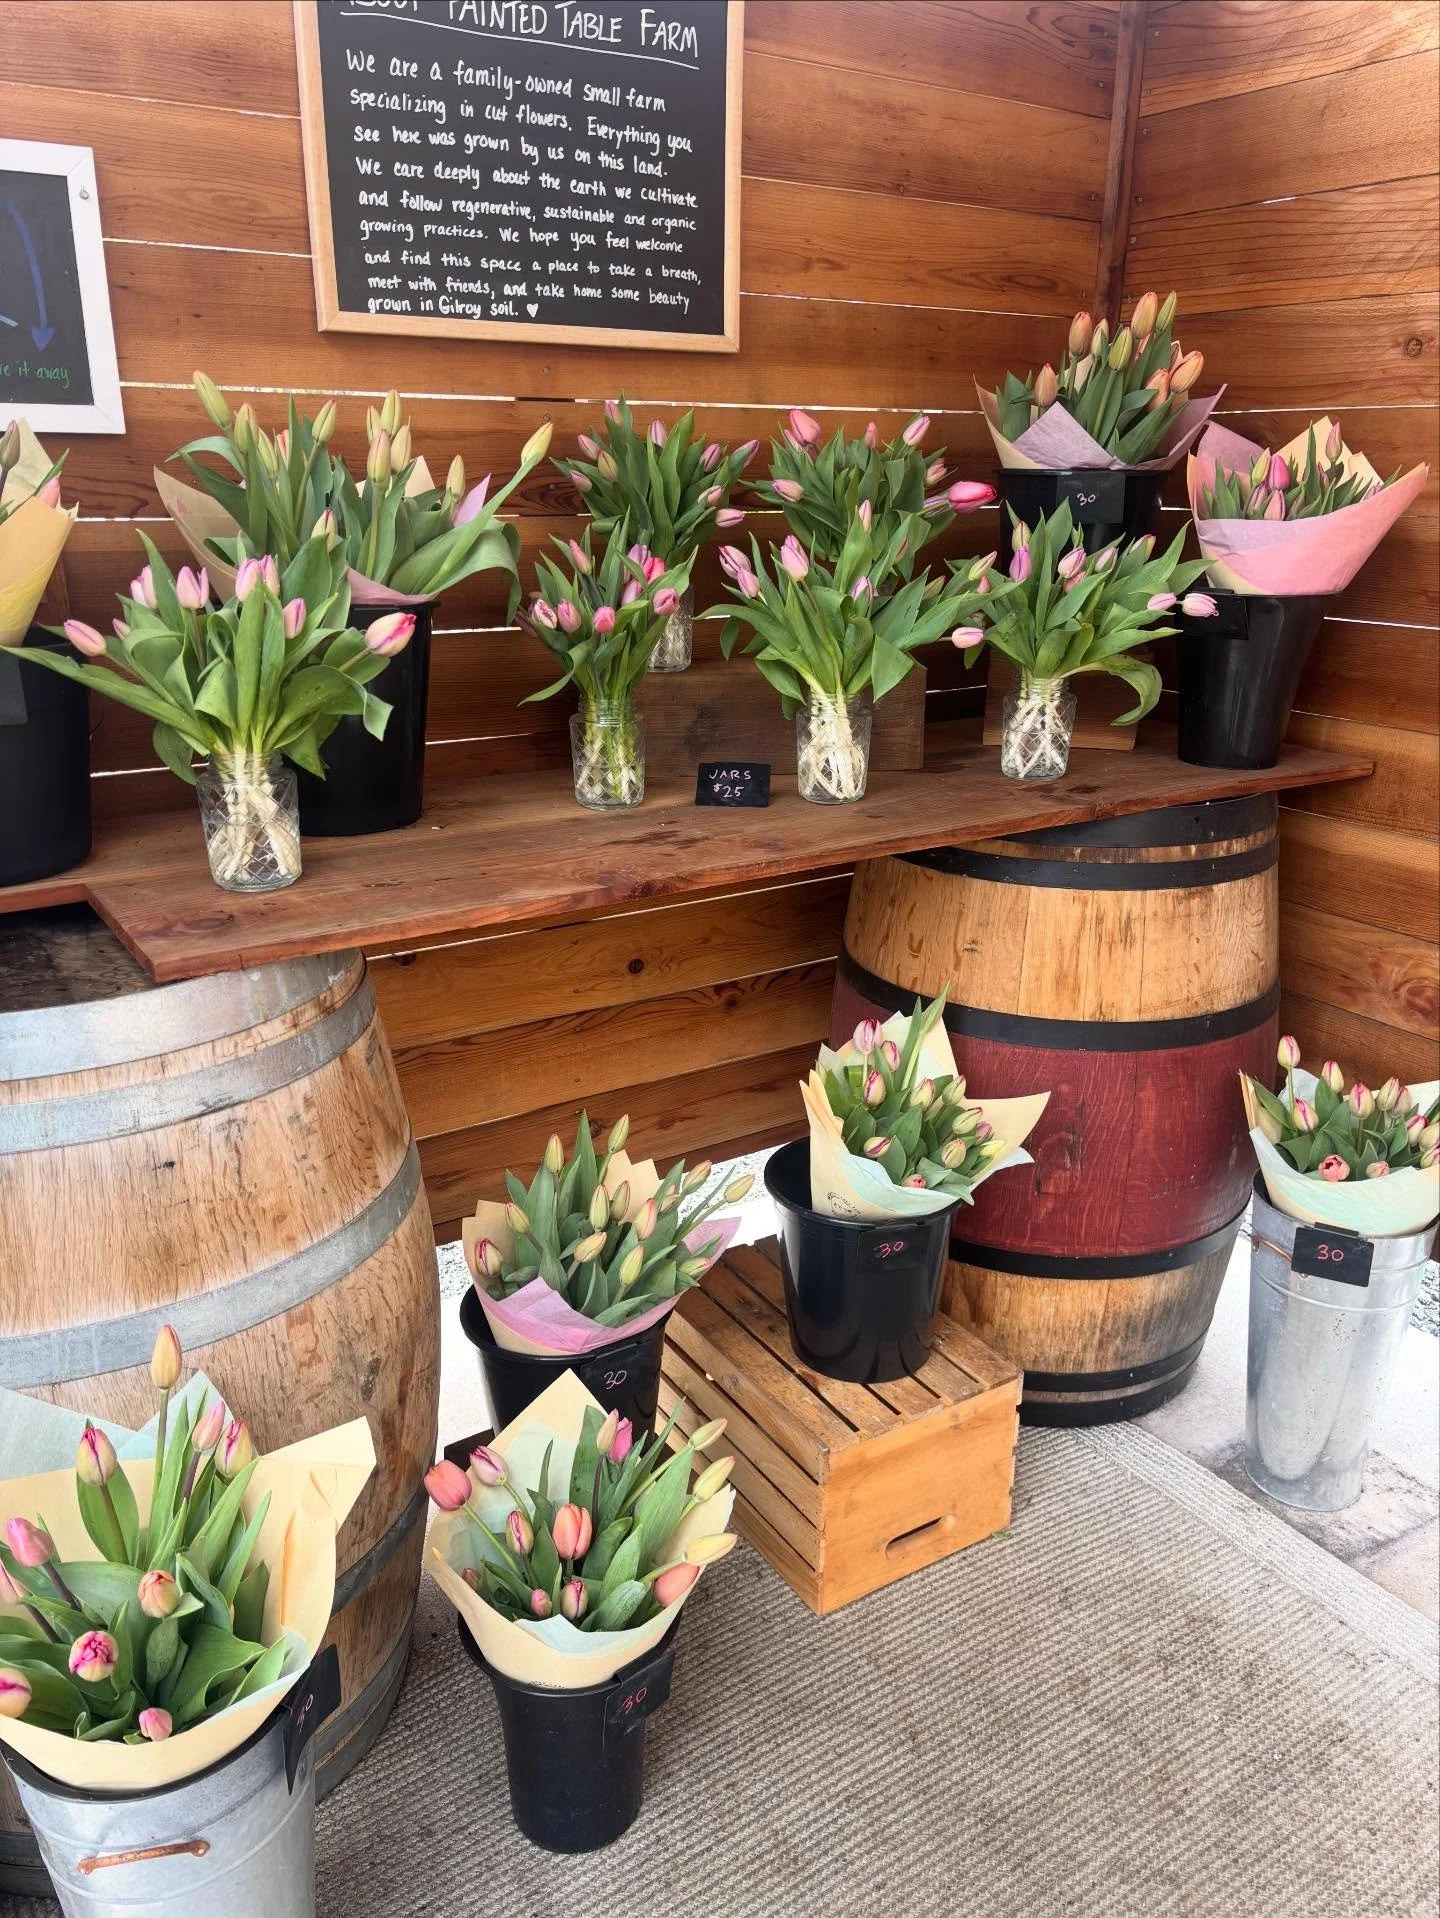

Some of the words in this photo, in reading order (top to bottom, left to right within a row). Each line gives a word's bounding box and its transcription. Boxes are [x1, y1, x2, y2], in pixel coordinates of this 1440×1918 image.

[555, 1, 622, 42] TABLE
[640, 9, 698, 58] FARM
[346, 49, 375, 73] We
[390, 57, 418, 78] are
[430, 62, 442, 80] a
[453, 60, 572, 100] family-owned
[583, 84, 620, 106] small
[626, 88, 665, 112] farm
[350, 89, 446, 124] specializing
[461, 100, 473, 117] in
[485, 105, 508, 121] cut
[515, 104, 572, 131] flowers.
[587, 116, 660, 156] Everything
[668, 135, 692, 157] you
[354, 126, 380, 142] see
[392, 126, 421, 144] here
[428, 132, 456, 145] was
[464, 134, 509, 154] grown
[521, 136, 539, 165] by
[548, 147, 564, 160] us
[575, 149, 591, 164] on
[598, 151, 624, 170] this
[634, 155, 667, 177] land.
[356, 156, 382, 175] We
[394, 162, 424, 178] care
[434, 161, 479, 190] deeply
[493, 167, 530, 185] about
[539, 172, 560, 190] the
[570, 179, 606, 196] earth
[615, 187, 631, 199] we
[641, 188, 698, 207] cultivate
[359, 191, 388, 207] and
[400, 190, 442, 211] follow
[452, 200, 535, 222] regenerative,
[544, 206, 614, 223] sustainable
[624, 214, 645, 226] and
[652, 218, 696, 234] organic
[360, 220, 413, 242] growing
[424, 225, 488, 238] practices.
[499, 228, 519, 242] We
[529, 228, 559, 246] hope
[571, 232, 596, 251] you
[606, 231, 629, 249] feel
[636, 238, 682, 252] welcome
[365, 250, 390, 264] and
[401, 250, 431, 265] find
[441, 253, 471, 267] this
[481, 258, 521, 273] space
[533, 261, 541, 270] a
[548, 260, 578, 274] place
[587, 261, 600, 274] to
[609, 264, 635, 276] take
[646, 268, 652, 276] a
[662, 265, 700, 285] breath,
[368, 275, 402, 289] meet
[408, 276, 436, 291] with
[445, 276, 495, 300] friends,
[504, 282, 527, 296] and
[535, 283, 564, 297] take
[574, 284, 602, 298] home
[612, 287, 639, 301] some
[649, 288, 689, 314] beauty
[368, 297, 412, 313] grown
[420, 297, 433, 311] in
[438, 295, 481, 318] Gilroy
[490, 301, 518, 316] soil.
[16, 360, 30, 377] it
[36, 367, 70, 389] away
[1076, 492, 1097, 506] 30
[709, 770, 752, 780] JARS
[713, 783, 745, 798] $25
[880, 1241, 904, 1258] 30
[1317, 1244, 1344, 1262] 30
[603, 1370, 627, 1390] 30
[621, 1687, 647, 1716] 30
